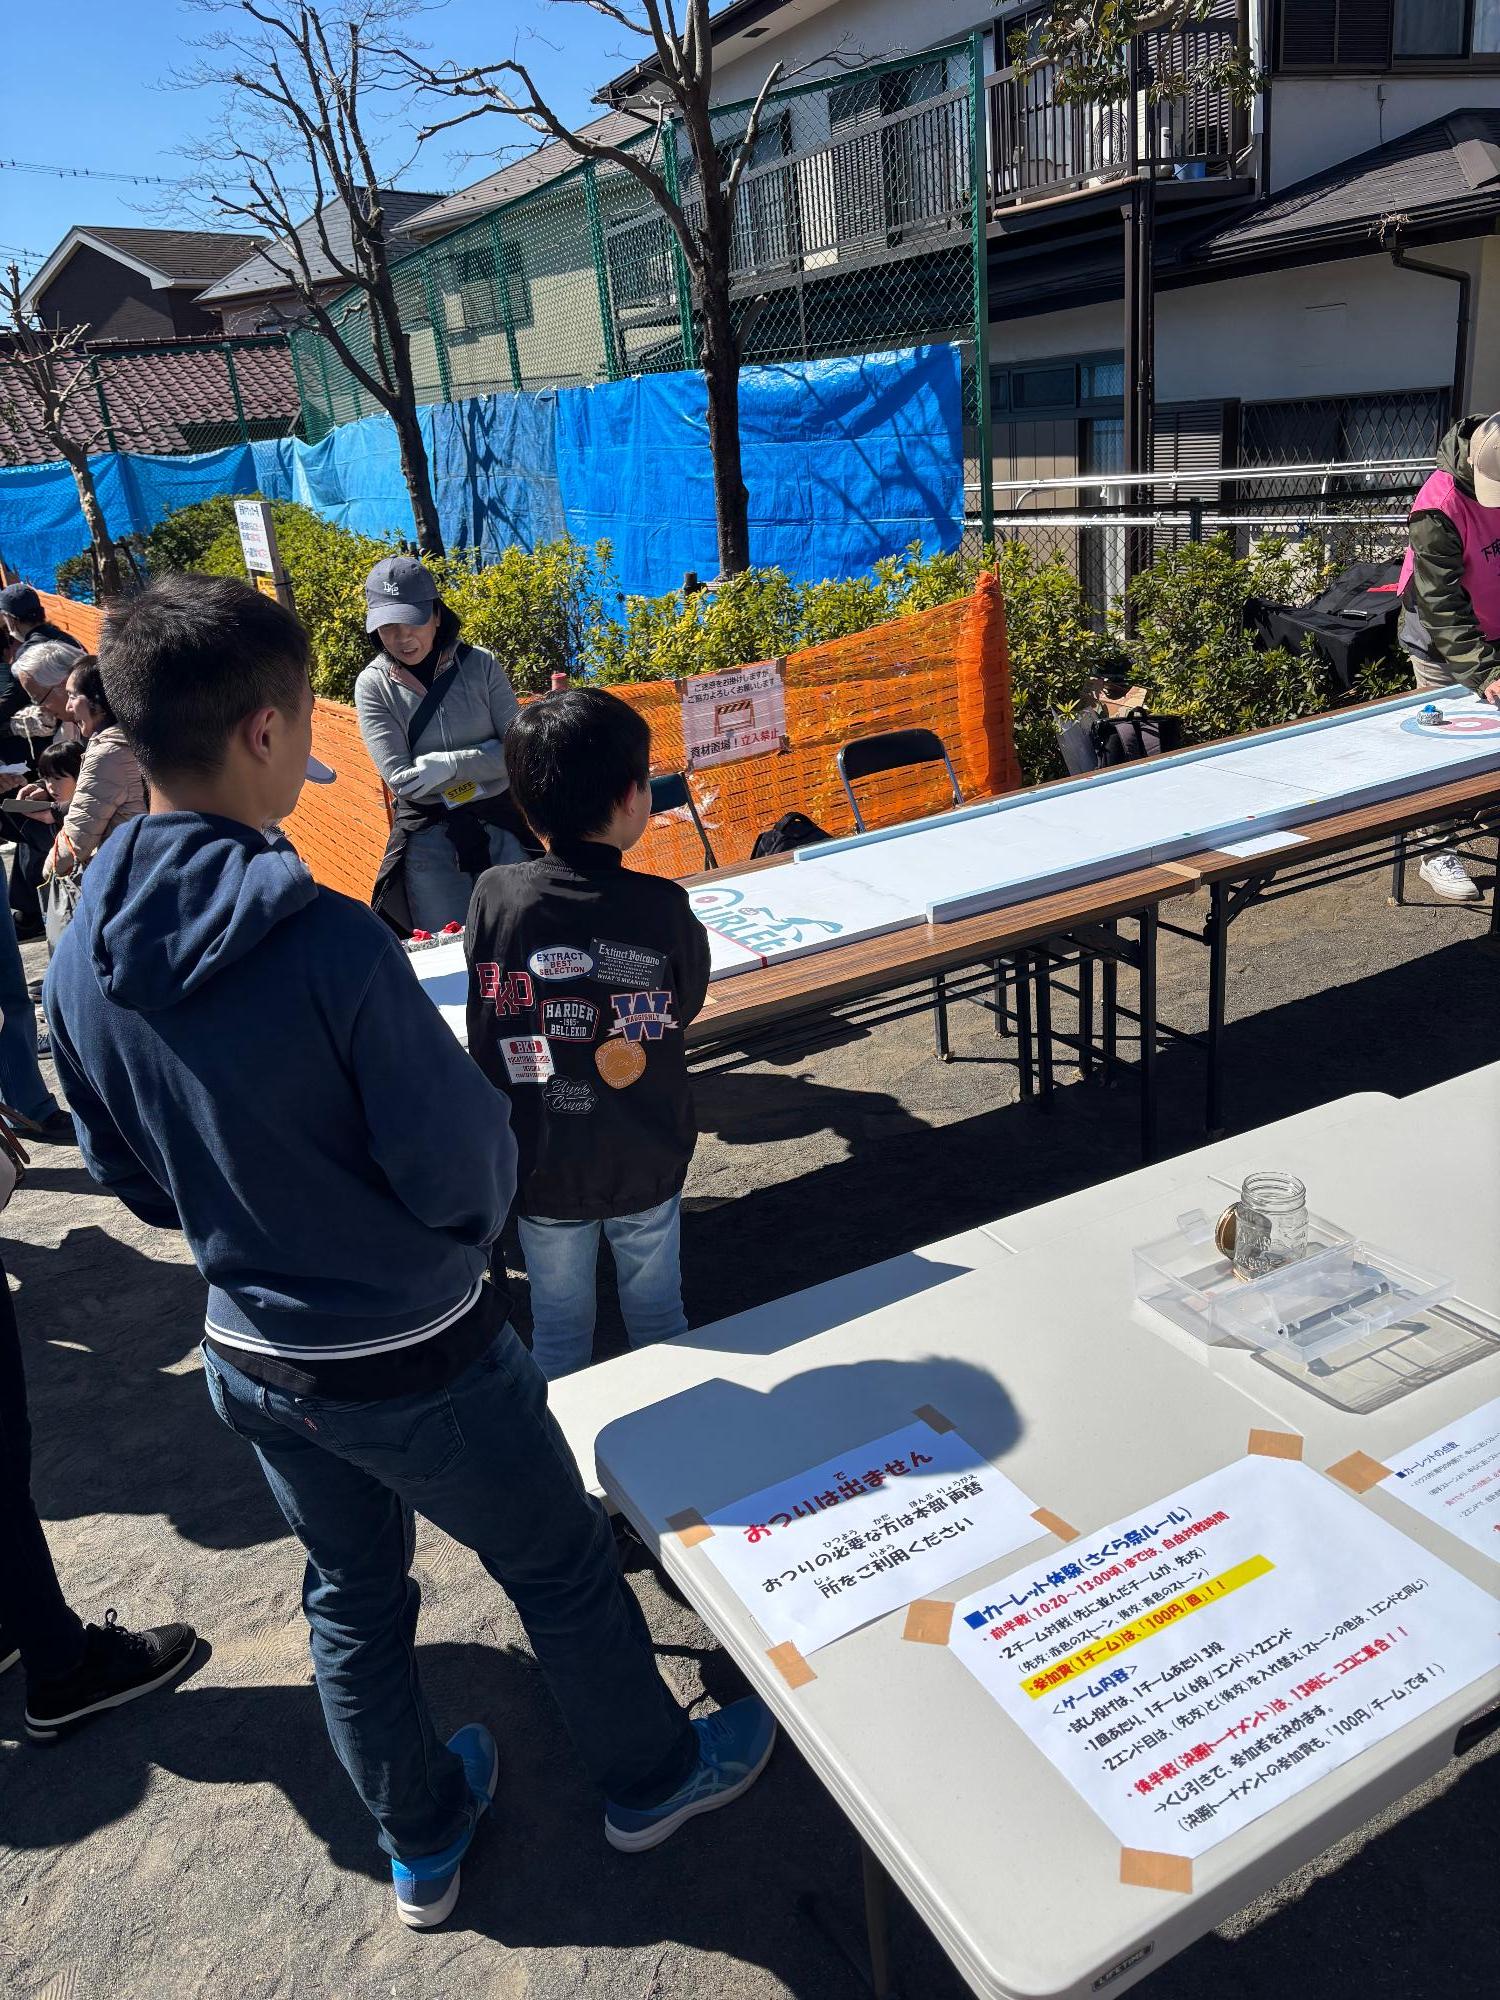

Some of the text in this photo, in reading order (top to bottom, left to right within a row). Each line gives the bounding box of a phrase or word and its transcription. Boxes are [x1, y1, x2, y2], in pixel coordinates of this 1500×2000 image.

[447, 781, 473, 798] STAFF
[536, 952, 584, 962] EXTRACT
[550, 961, 572, 969] BEST
[539, 966, 585, 976] SELECTION
[545, 1002, 594, 1022] HARDER
[743, 1451, 933, 1543] おつりは出ません
[822, 1529, 858, 1548] ひつよう
[818, 1517, 974, 1599] 所をご利用ください
